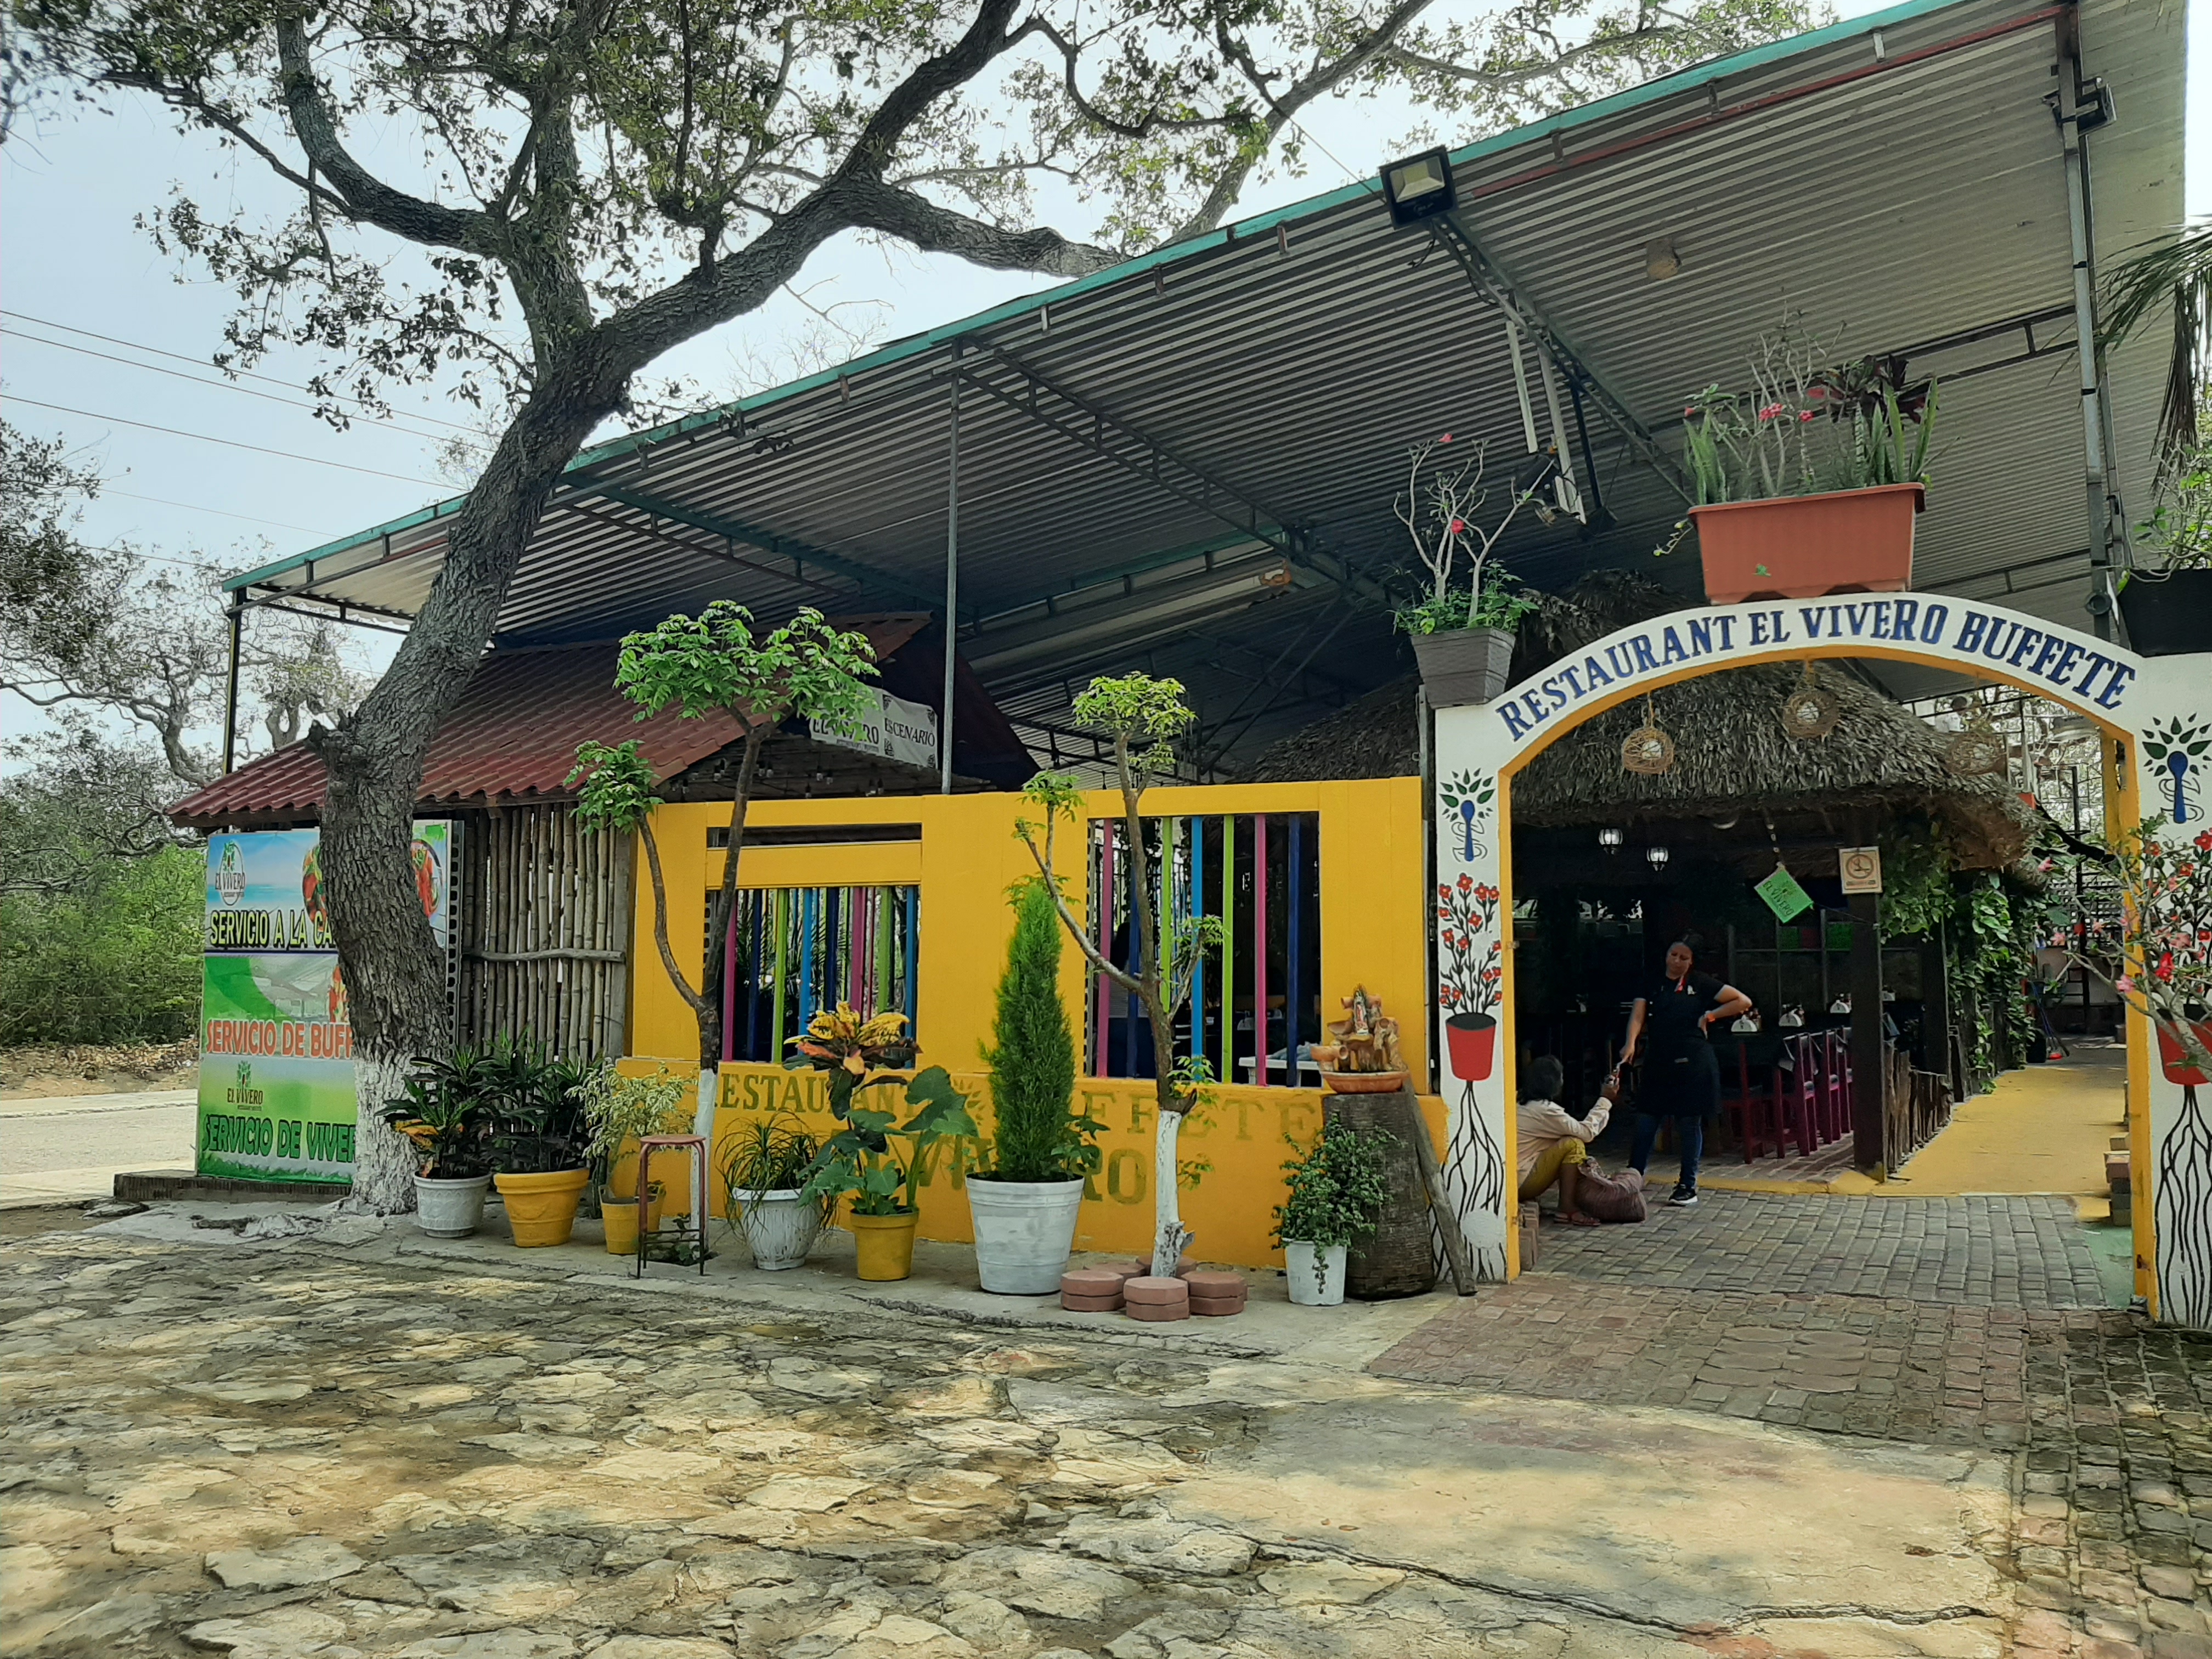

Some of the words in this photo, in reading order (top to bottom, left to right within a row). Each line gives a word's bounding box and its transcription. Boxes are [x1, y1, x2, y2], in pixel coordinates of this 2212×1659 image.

[1495, 615, 1737, 742] RESTAURANT
[1748, 610, 1790, 646] EL
[1799, 599, 1949, 645] VIVERO
[1953, 611, 2136, 710] BUFFETE
[884, 718, 935, 747] ESCENARIO
[223, 872, 246, 890] VIVERO
[1771, 888, 1795, 916] VIVERO
[210, 909, 269, 949] SERVICIO
[273, 909, 285, 949] A
[290, 909, 308, 949] LA
[314, 910, 336, 949] CA
[206, 1019, 276, 1056] SERVICIO
[281, 1021, 306, 1057] DE
[236, 1088, 263, 1105] VIVERO
[202, 1114, 273, 1157] SERVICIO
[277, 1119, 302, 1159] DE
